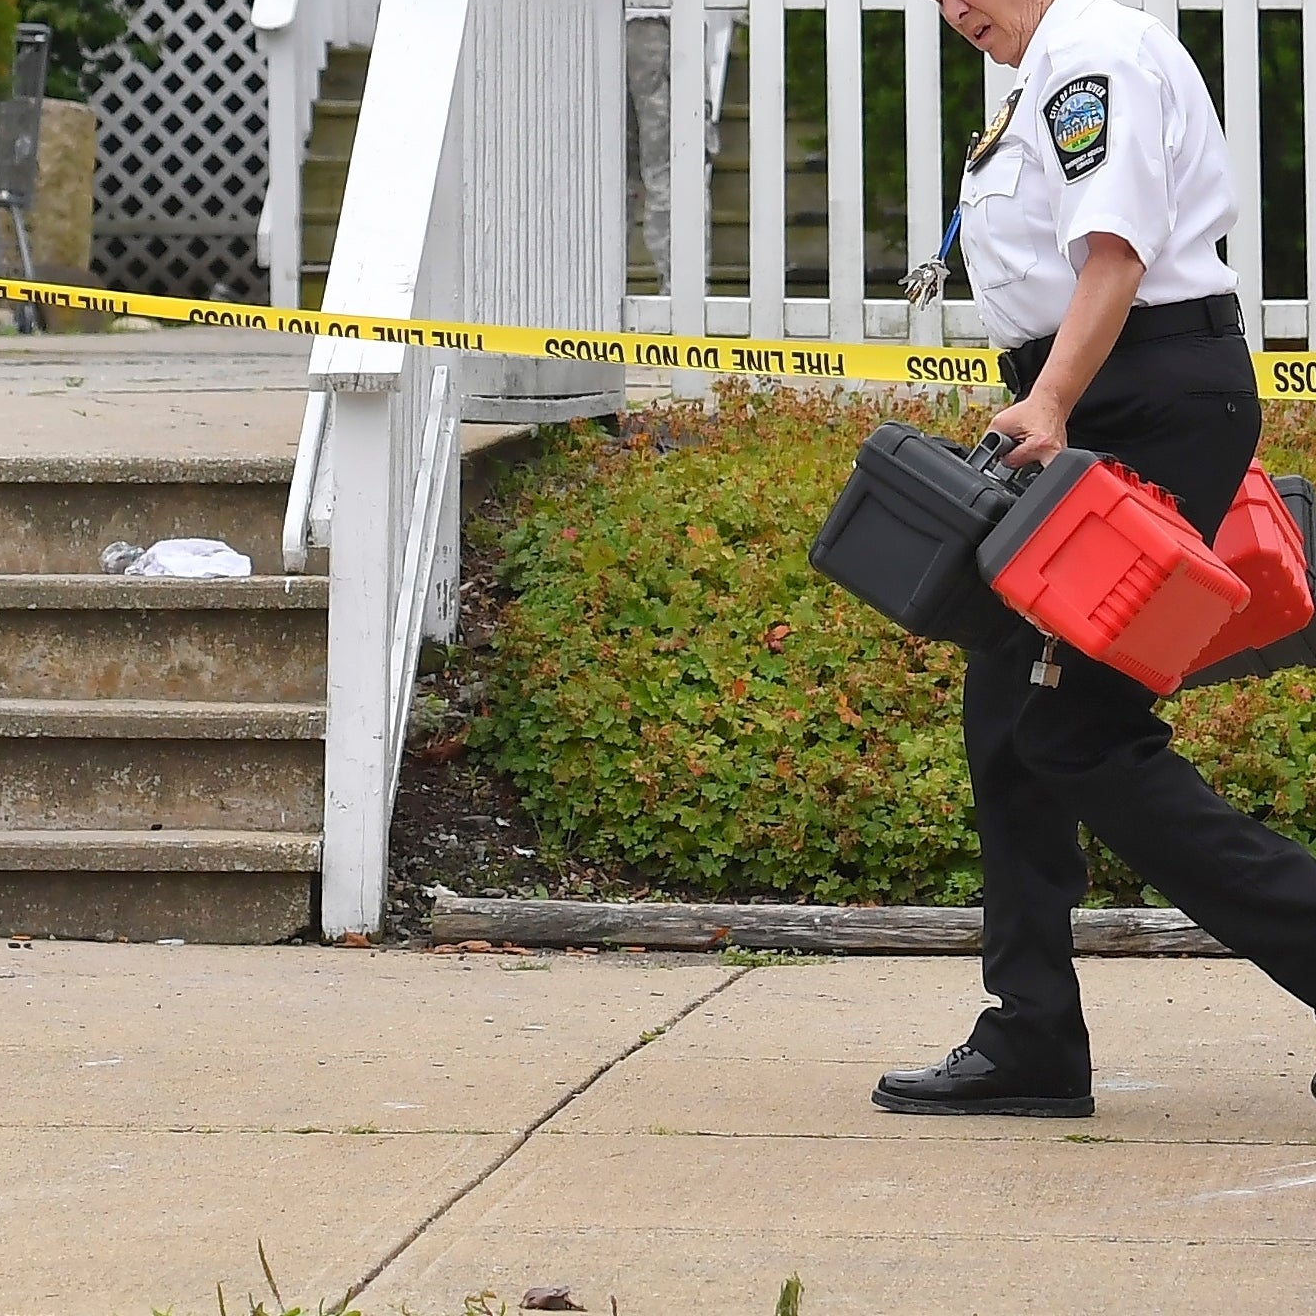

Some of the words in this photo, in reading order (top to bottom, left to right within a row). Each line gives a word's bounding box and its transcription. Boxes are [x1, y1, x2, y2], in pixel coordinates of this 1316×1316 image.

[1068, 81, 1085, 95] FALL
[544, 338, 625, 364] CROSS
[635, 343, 681, 367] NOT
[686, 345, 721, 370] DO
[731, 348, 786, 374] LINE
[792, 351, 846, 377] FIRE
[906, 355, 988, 384] CROSS
